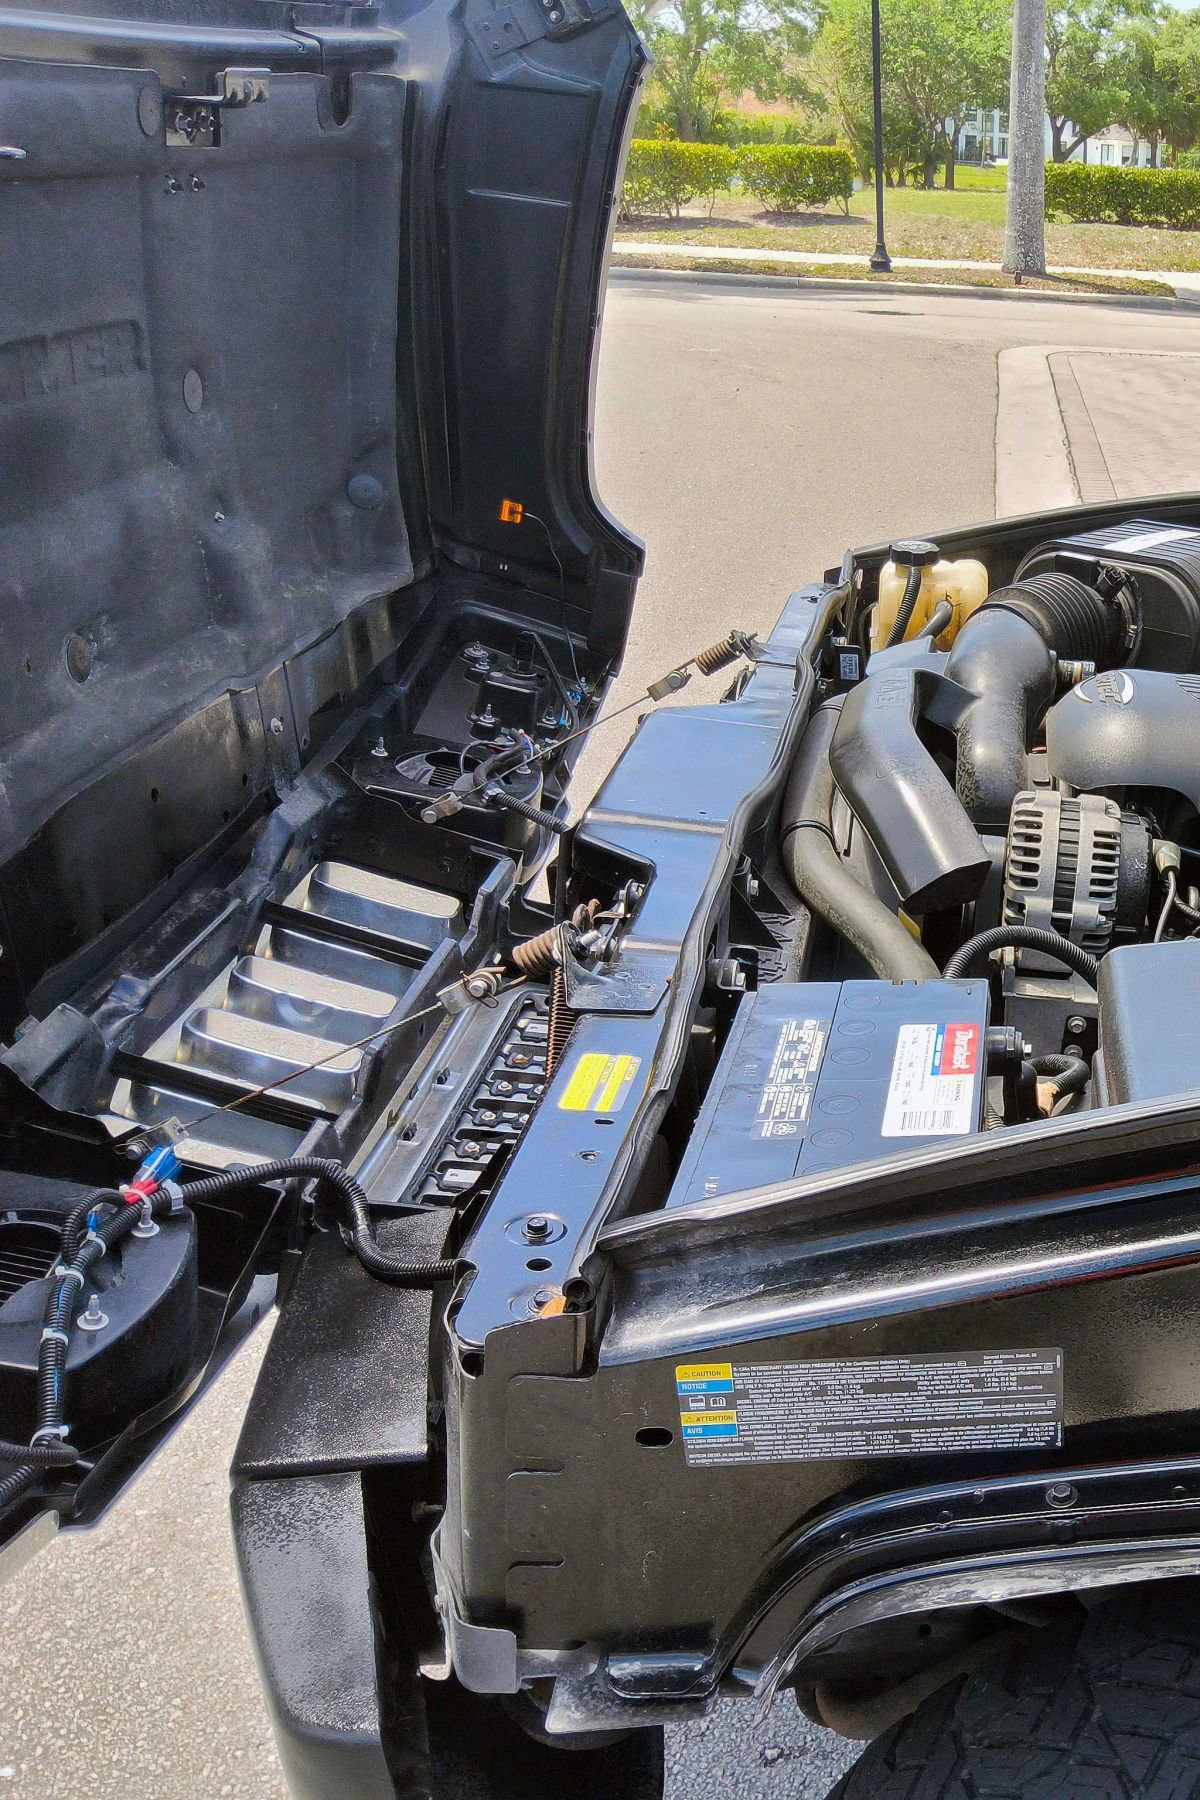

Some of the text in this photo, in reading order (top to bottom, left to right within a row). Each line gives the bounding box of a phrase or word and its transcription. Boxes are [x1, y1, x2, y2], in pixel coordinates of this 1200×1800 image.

[952, 1029, 974, 1070] Duralast
[681, 1382, 707, 1390] NOTICE
[696, 1414, 733, 1422] ATTENTION
